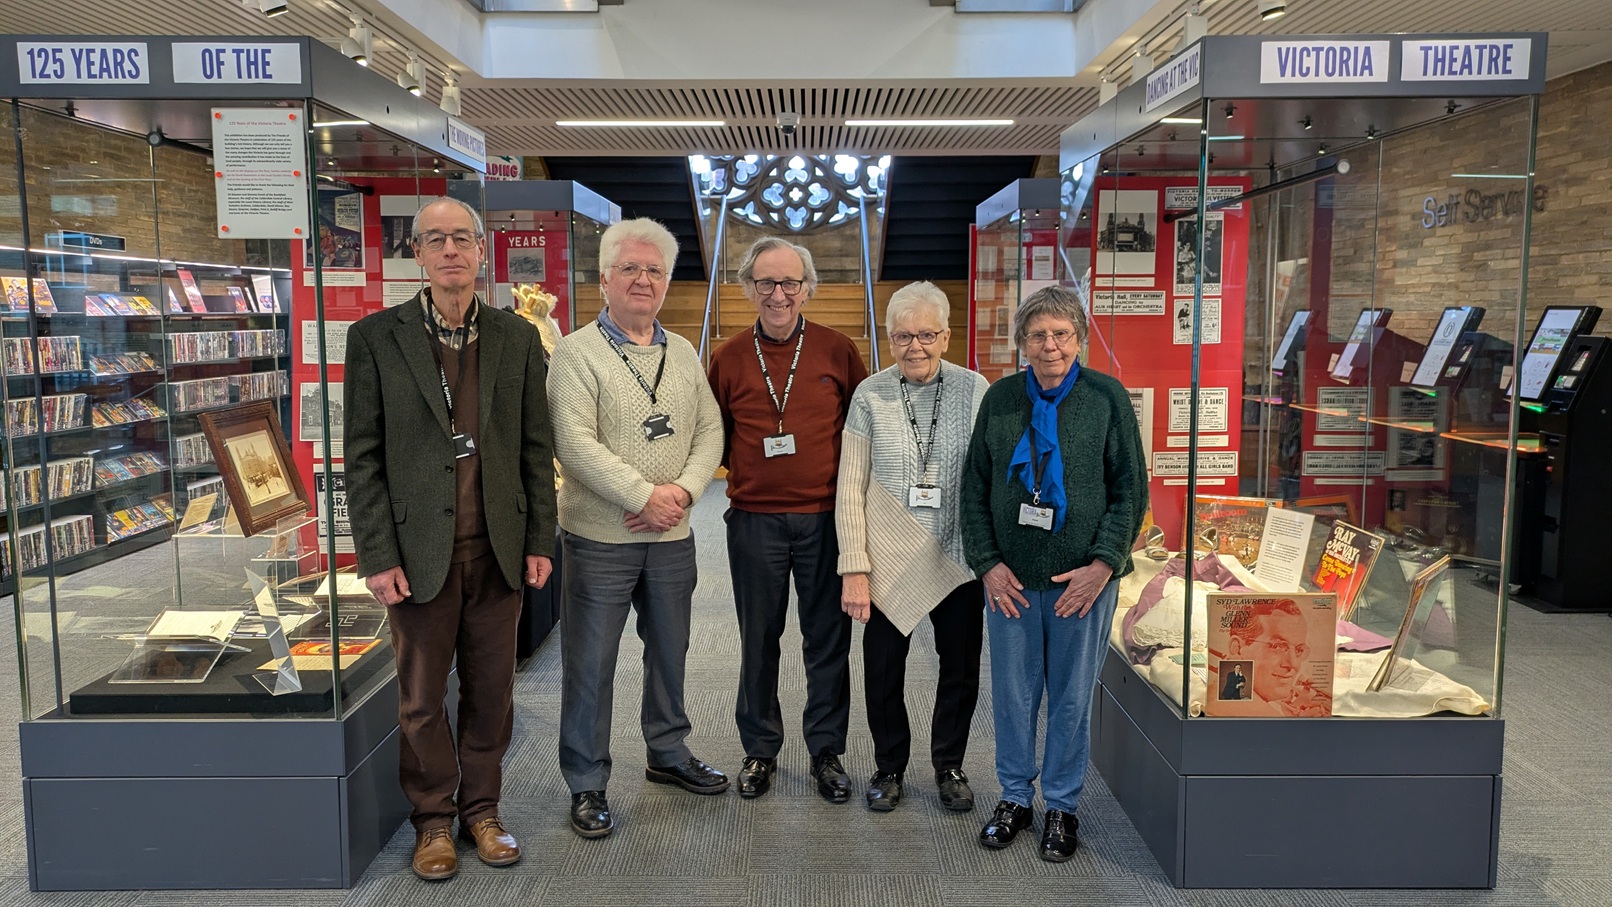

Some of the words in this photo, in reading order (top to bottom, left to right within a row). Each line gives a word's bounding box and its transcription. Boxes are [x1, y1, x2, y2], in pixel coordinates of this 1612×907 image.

[27, 48, 64, 79] 125
[74, 48, 141, 80] YEARS
[201, 48, 226, 79] OF
[231, 48, 273, 80] THE
[1277, 46, 1374, 78] VICTORIA
[1419, 43, 1513, 76] THEATRE
[1147, 71, 1169, 105] DANCING
[1169, 65, 1177, 92] AT
[1177, 58, 1188, 87] THE
[1189, 51, 1199, 80] VIC
[456, 128, 469, 150] MOVING
[485, 162, 519, 178] ADING
[1422, 196, 1460, 229] Self
[89, 237, 103, 245] DVDs
[508, 235, 546, 247] YEARS
[1334, 526, 1356, 544] RAY
